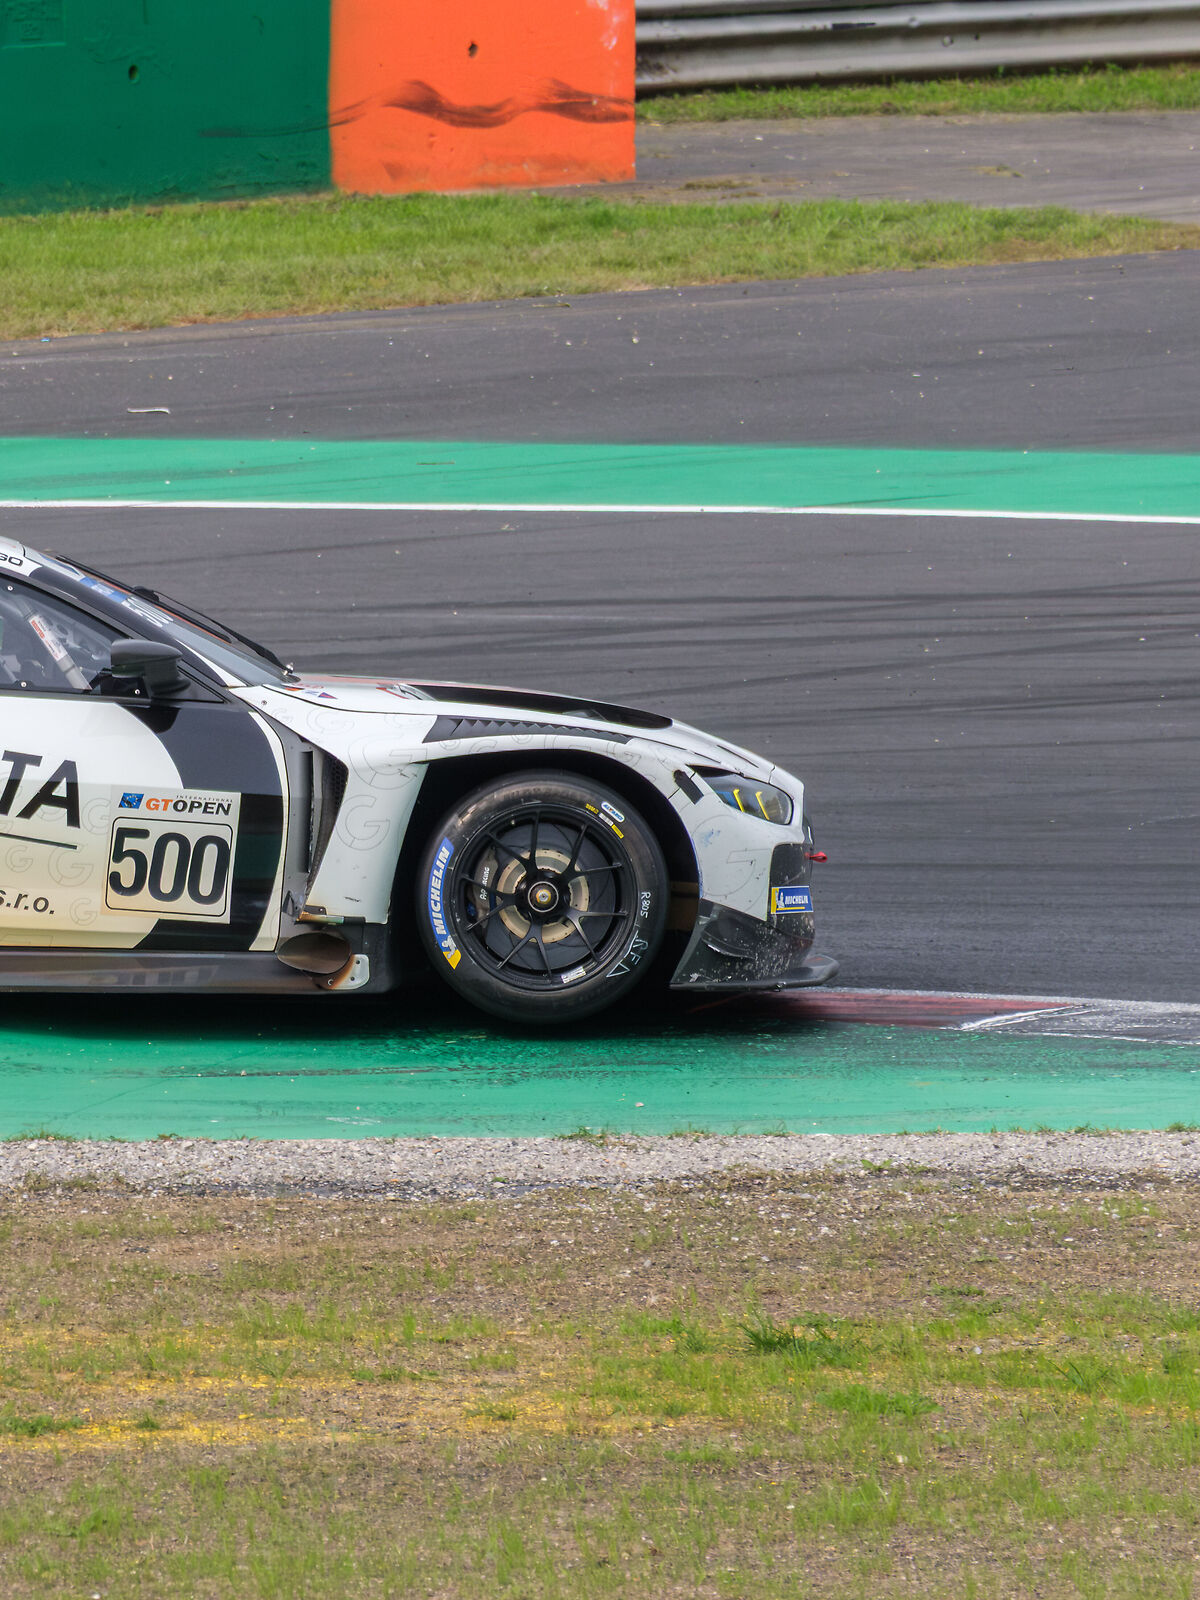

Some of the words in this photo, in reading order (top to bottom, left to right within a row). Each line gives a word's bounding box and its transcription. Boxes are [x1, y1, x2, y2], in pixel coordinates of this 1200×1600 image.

[176, 795, 233, 803] INTERNATIONAL
[108, 827, 231, 906] 500
[482, 866, 491, 887] ACING
[430, 846, 451, 936] MICHELIN
[785, 896, 808, 904] MICHELIN
